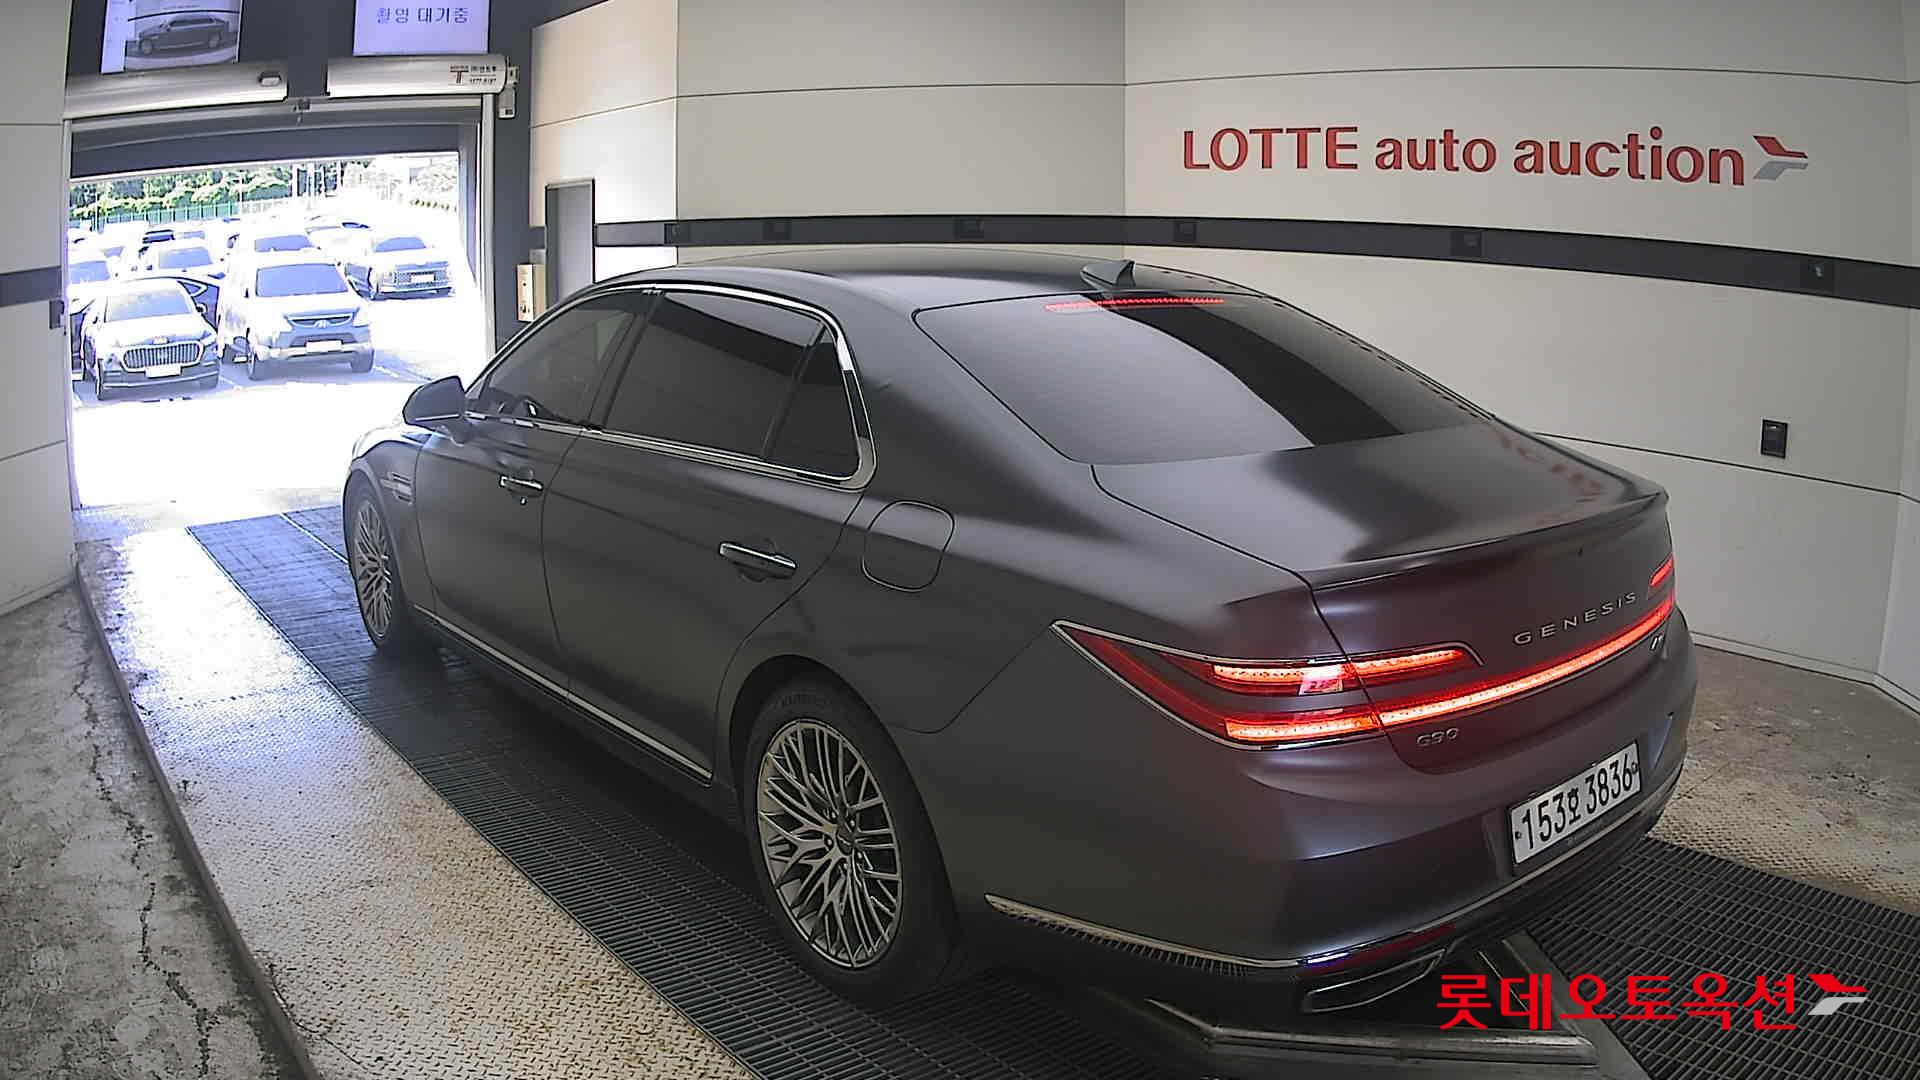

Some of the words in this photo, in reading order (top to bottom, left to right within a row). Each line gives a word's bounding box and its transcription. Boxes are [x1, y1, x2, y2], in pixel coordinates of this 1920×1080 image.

[418, 7, 469, 24] 대기중
[1183, 126, 1359, 170] LOTTE
[1375, 129, 1497, 173] auto
[1513, 127, 1745, 186] auction
[1513, 591, 1638, 645] GENESIS
[1416, 727, 1460, 747] G90
[1585, 753, 1633, 815] 3836
